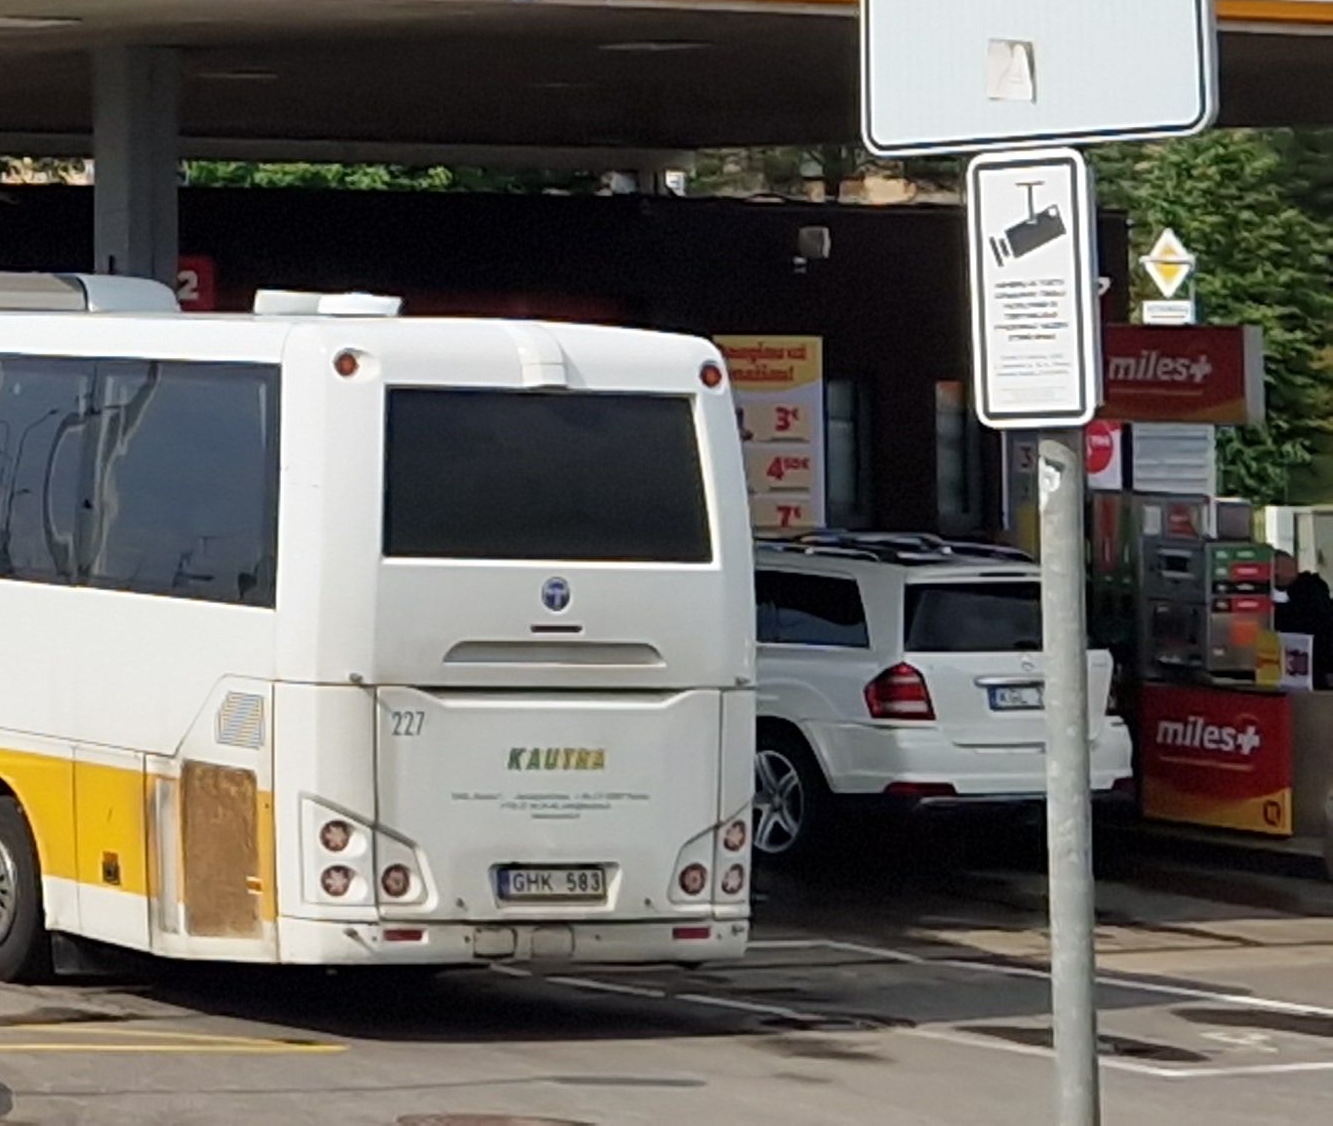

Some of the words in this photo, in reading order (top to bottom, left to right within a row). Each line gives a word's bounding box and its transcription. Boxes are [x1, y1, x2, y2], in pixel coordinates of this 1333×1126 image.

[177, 270, 199, 300] 2
[391, 712, 425, 736] 227
[507, 748, 607, 771] KAUTRA
[513, 869, 552, 891] GHK
[566, 868, 601, 890] 583
